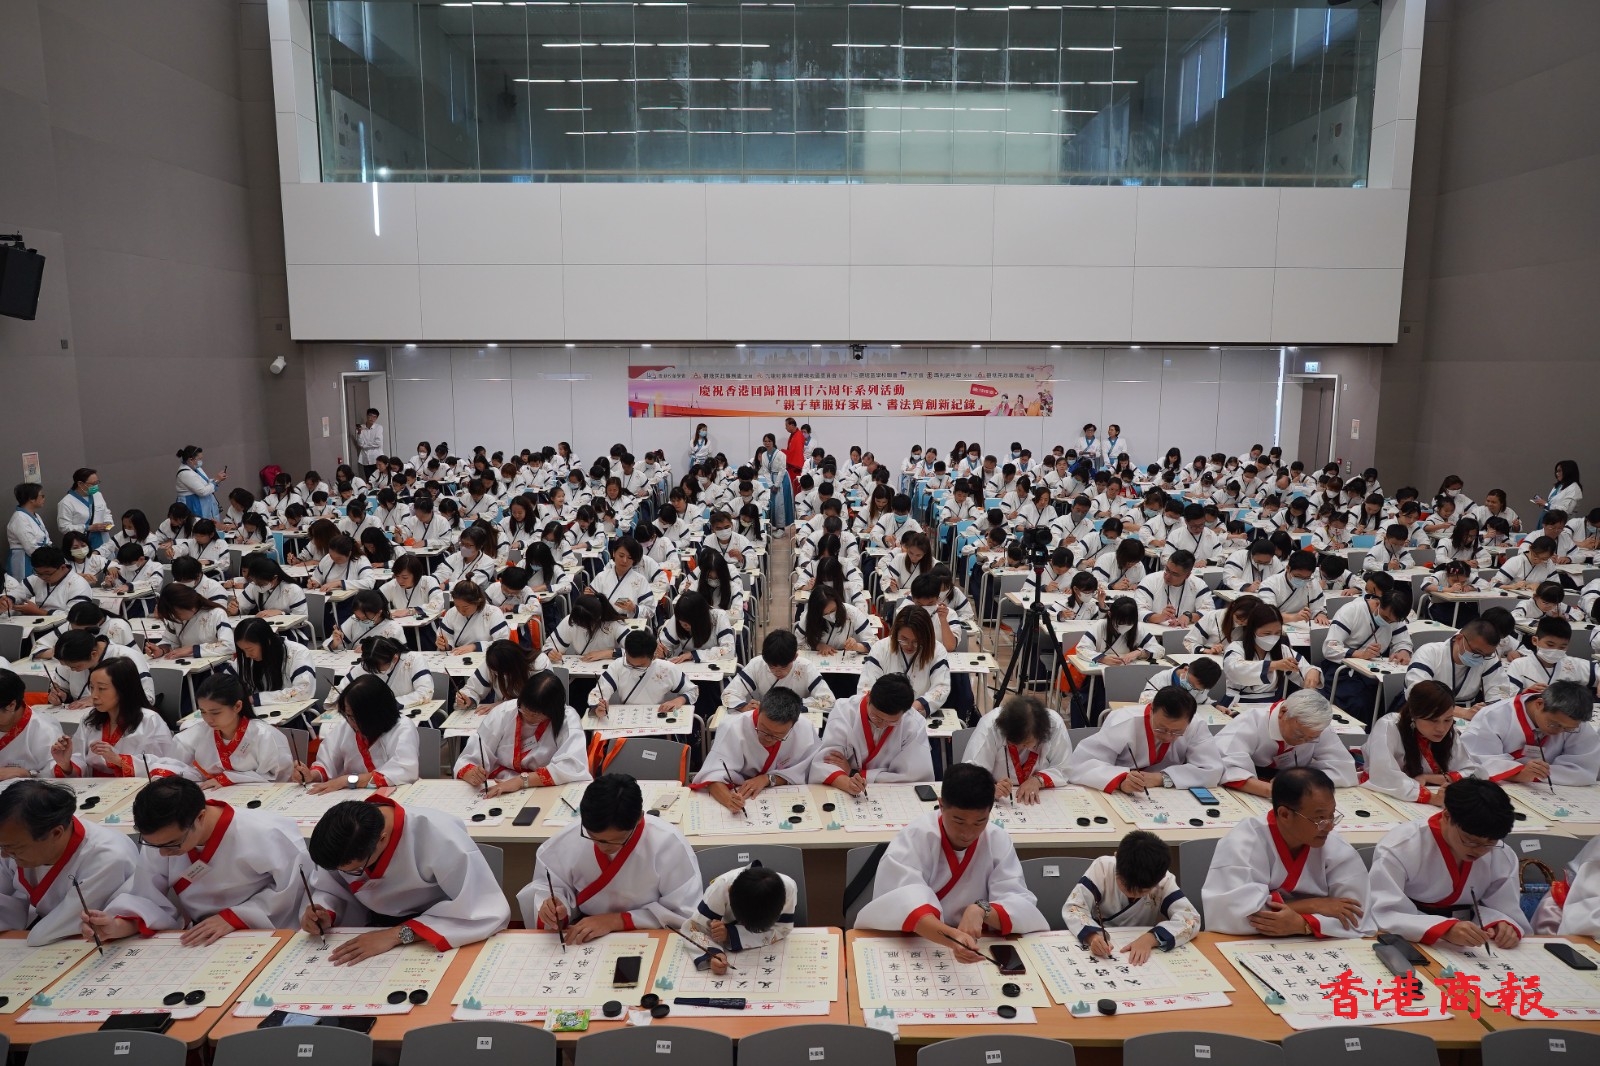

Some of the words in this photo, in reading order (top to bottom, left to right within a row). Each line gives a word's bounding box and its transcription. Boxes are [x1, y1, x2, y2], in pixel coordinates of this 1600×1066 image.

[699, 384, 905, 397] 慶祝香港回歸祖國廿六周年系列活動
